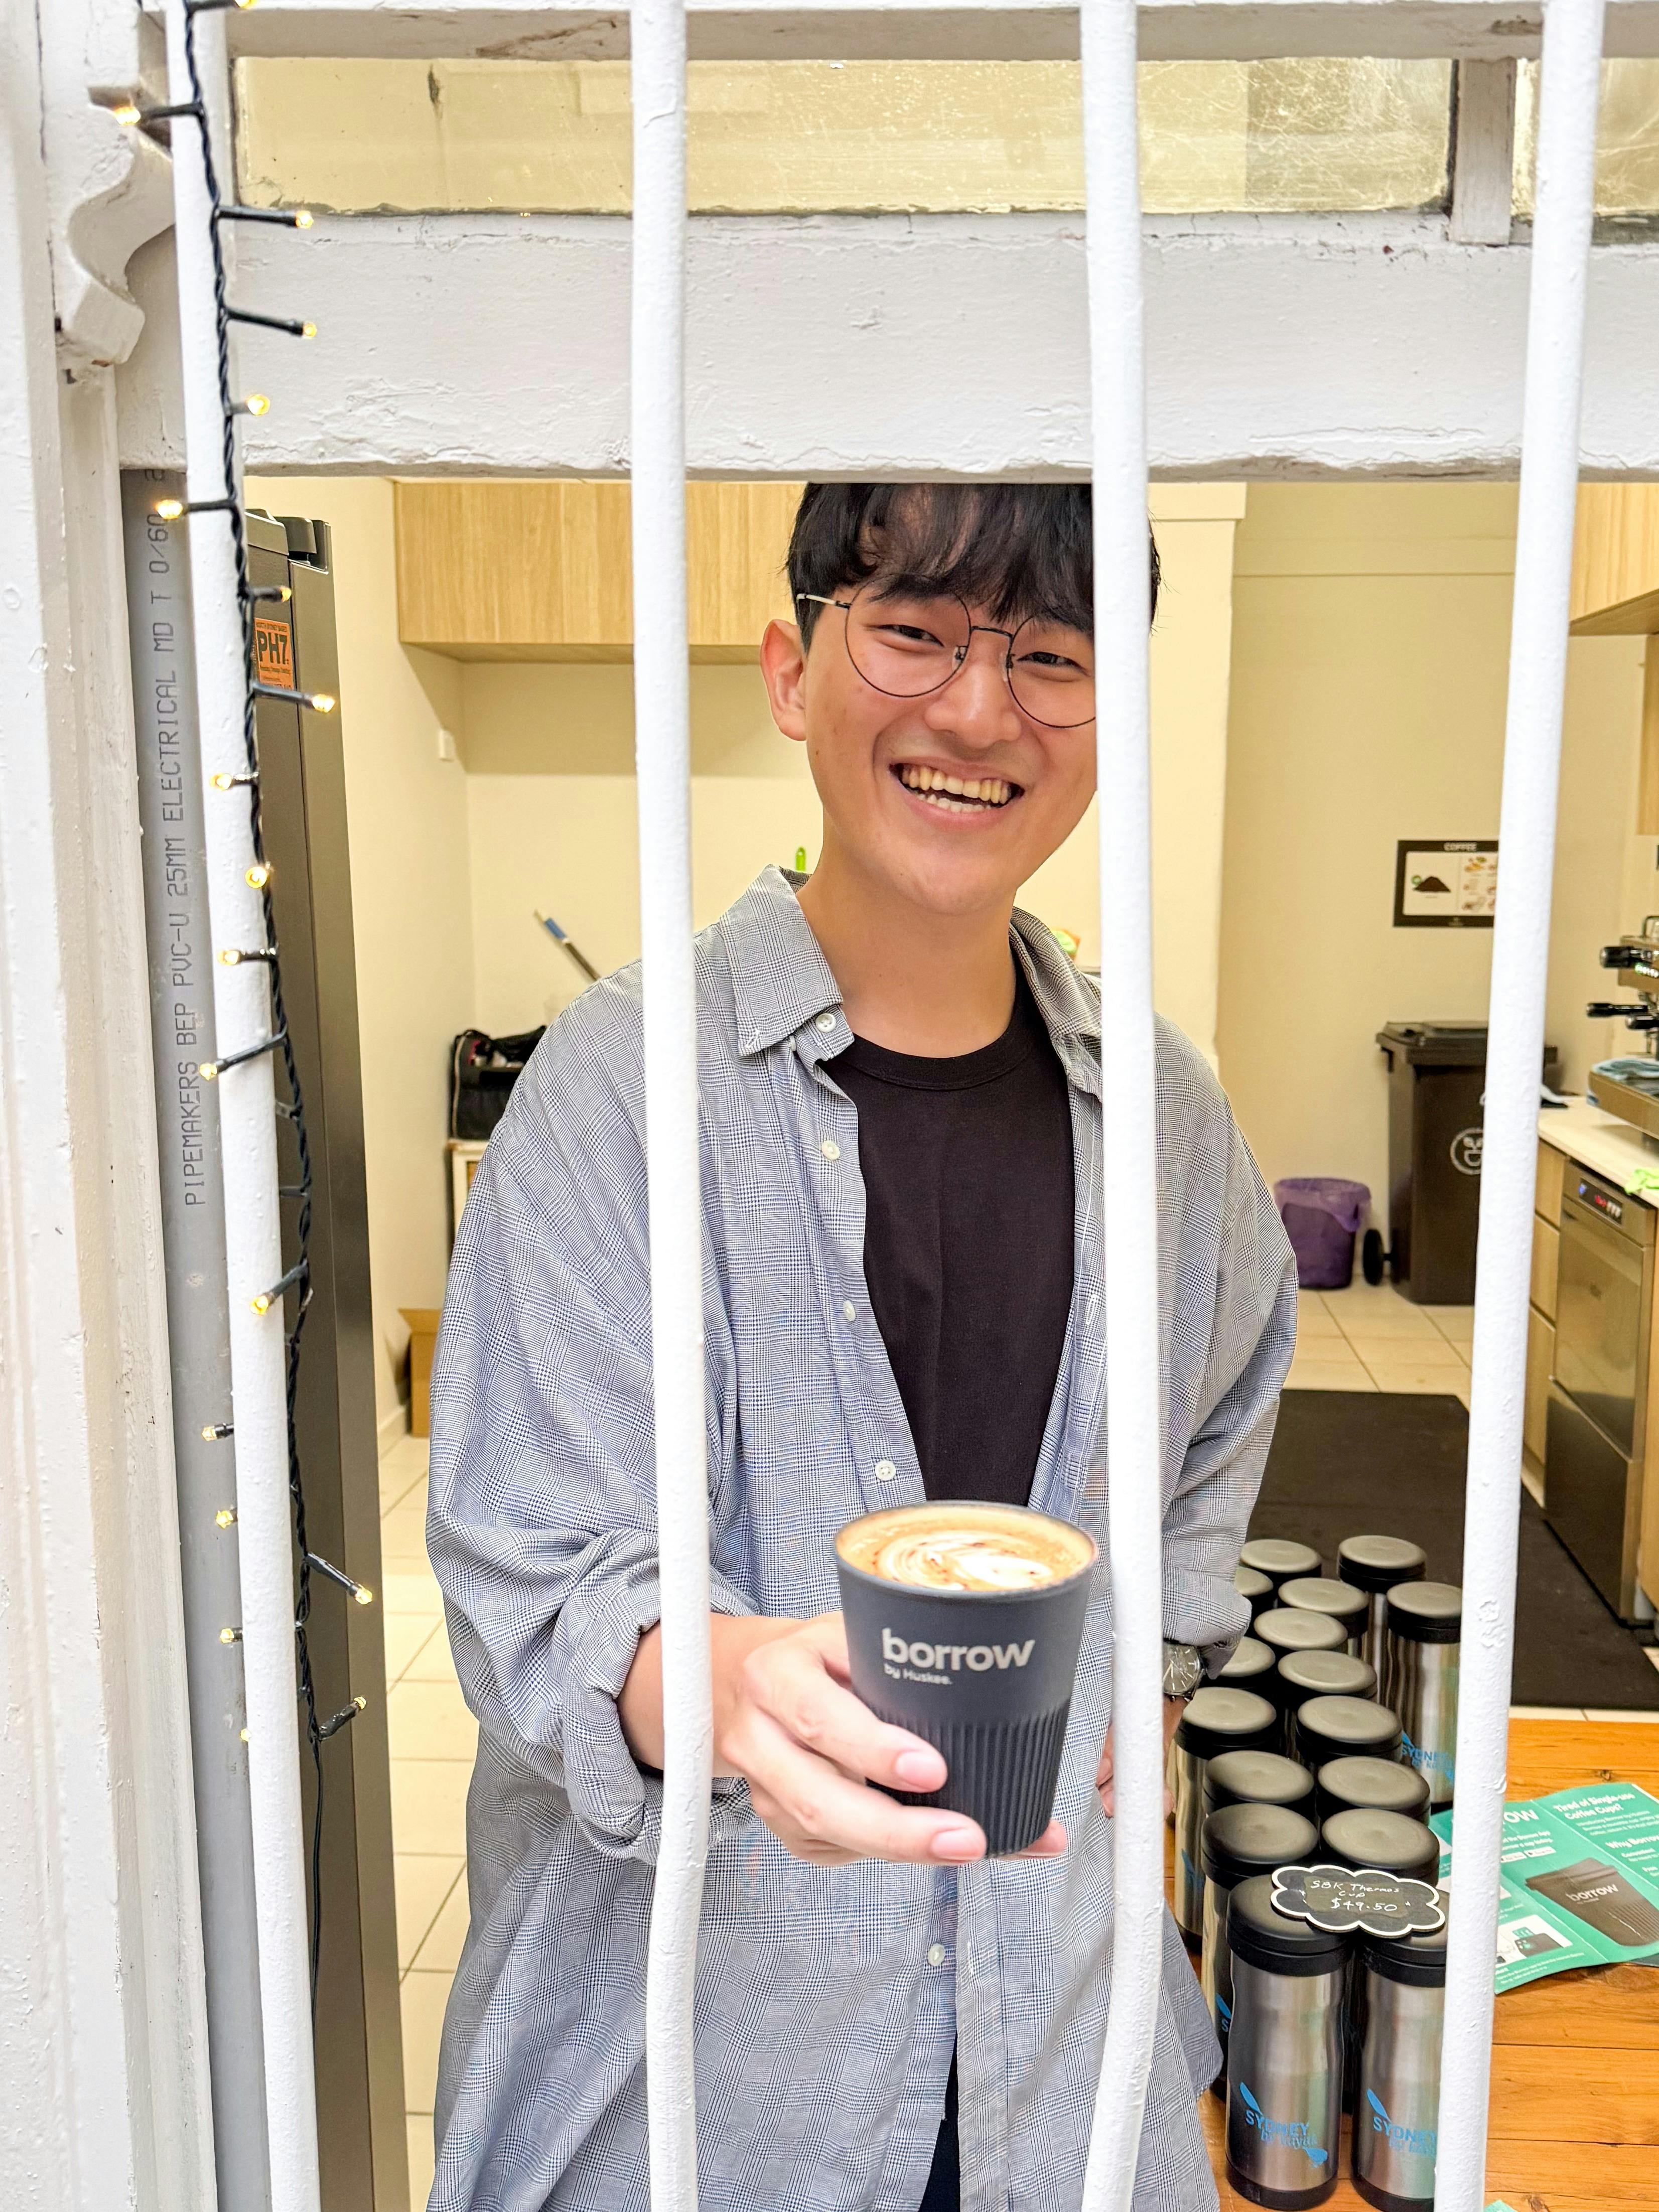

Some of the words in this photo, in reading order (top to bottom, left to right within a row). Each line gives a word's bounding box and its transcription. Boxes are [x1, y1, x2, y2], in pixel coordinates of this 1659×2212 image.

[153, 622, 174, 652] MD
[156, 670, 184, 821] ELECTRICAL
[165, 837, 189, 897] 25MM
[169, 913, 193, 986] PVC-U
[174, 1003, 197, 1045] BEP
[177, 1061, 205, 1205] PIPEMAKERS
[882, 1627, 1036, 1671] borrow
[884, 1663, 901, 1679] by
[1553, 1802, 1580, 1812] Tired
[1564, 1808, 1597, 1820] Coffee
[1627, 1835, 1659, 1845] Borro
[1331, 1897, 1398, 1911] $49.50
[1566, 1883, 1619, 1902] borrow
[1246, 2110, 1309, 2137] SYDNEY
